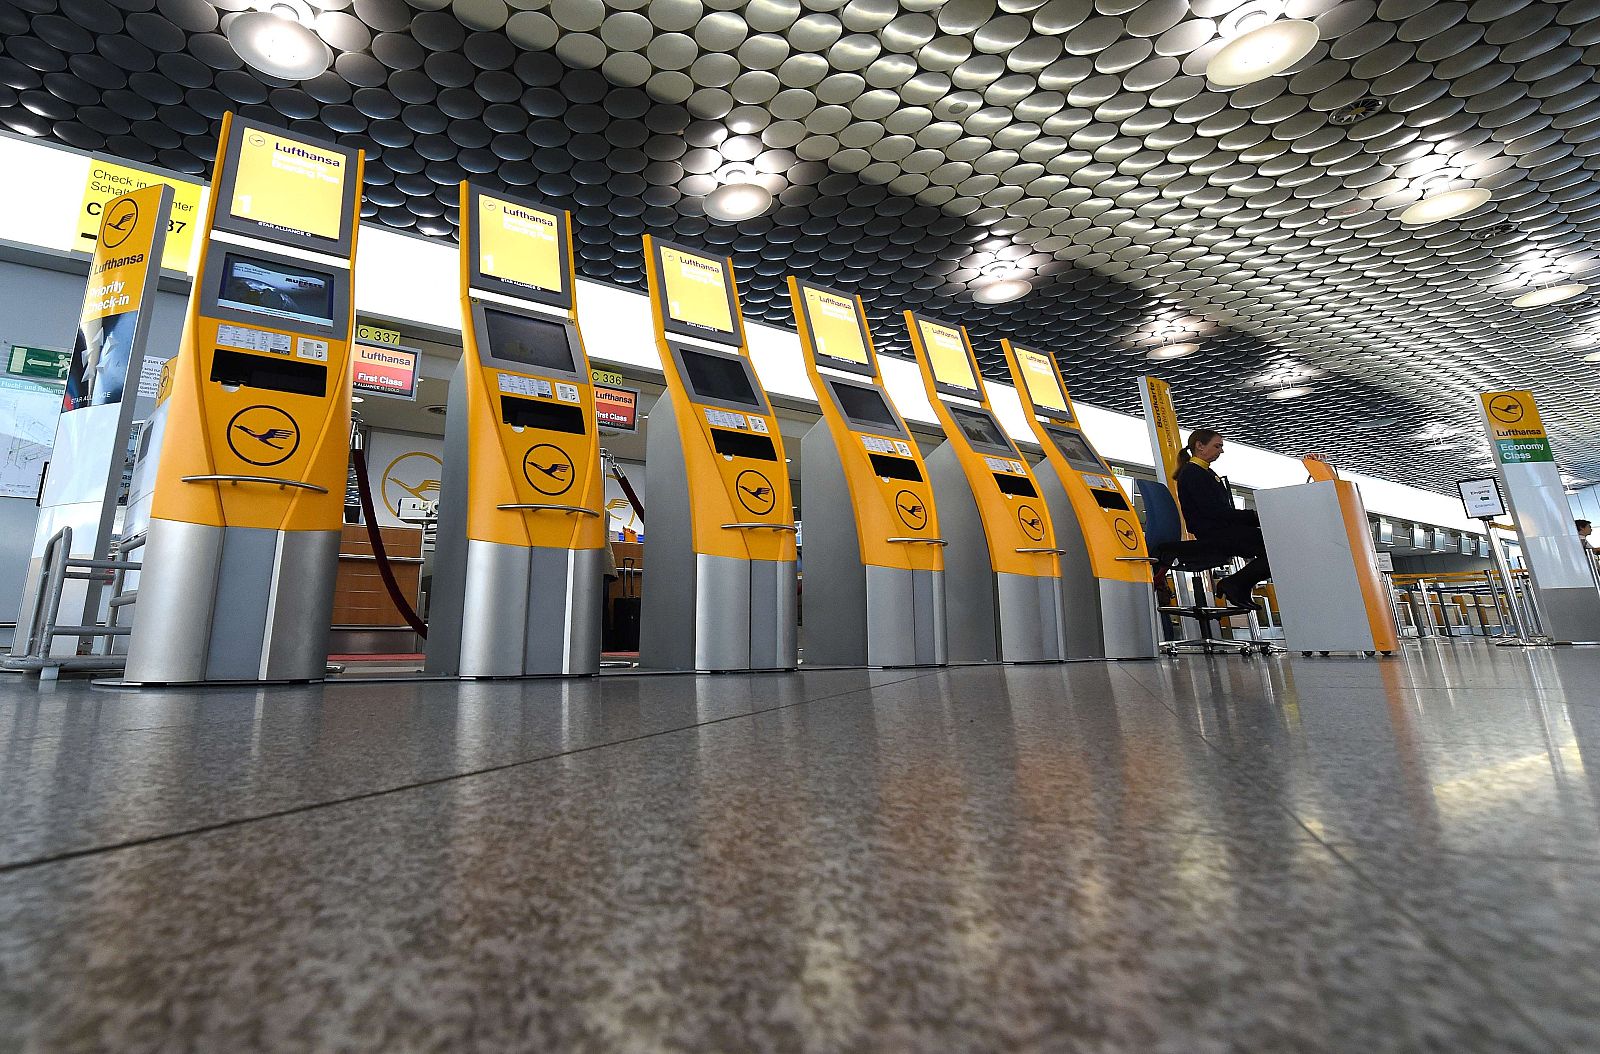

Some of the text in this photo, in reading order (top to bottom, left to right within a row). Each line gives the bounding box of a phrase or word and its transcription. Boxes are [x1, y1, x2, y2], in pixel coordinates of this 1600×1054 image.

[275, 142, 340, 168] Lufthansa
[93, 169, 147, 189] Check in
[86, 202, 102, 216] C
[503, 205, 553, 227] Lufthansa
[274, 225, 305, 236] ALLIANCE
[94, 253, 144, 275] Lufthansa
[679, 256, 720, 274] Lufthansa
[818, 295, 852, 310] Lufthansa
[359, 328, 399, 344] C 337
[361, 349, 411, 366] Lufthansa
[357, 372, 404, 387] First Class
[591, 371, 622, 385] C 336
[595, 391, 633, 404] Lufthansa
[1149, 381, 1163, 428] Bordkarte
[609, 413, 628, 422] Class
[1496, 428, 1542, 437] Lufthansa
[1500, 442, 1545, 452] Economy
[1503, 451, 1532, 460] Class
